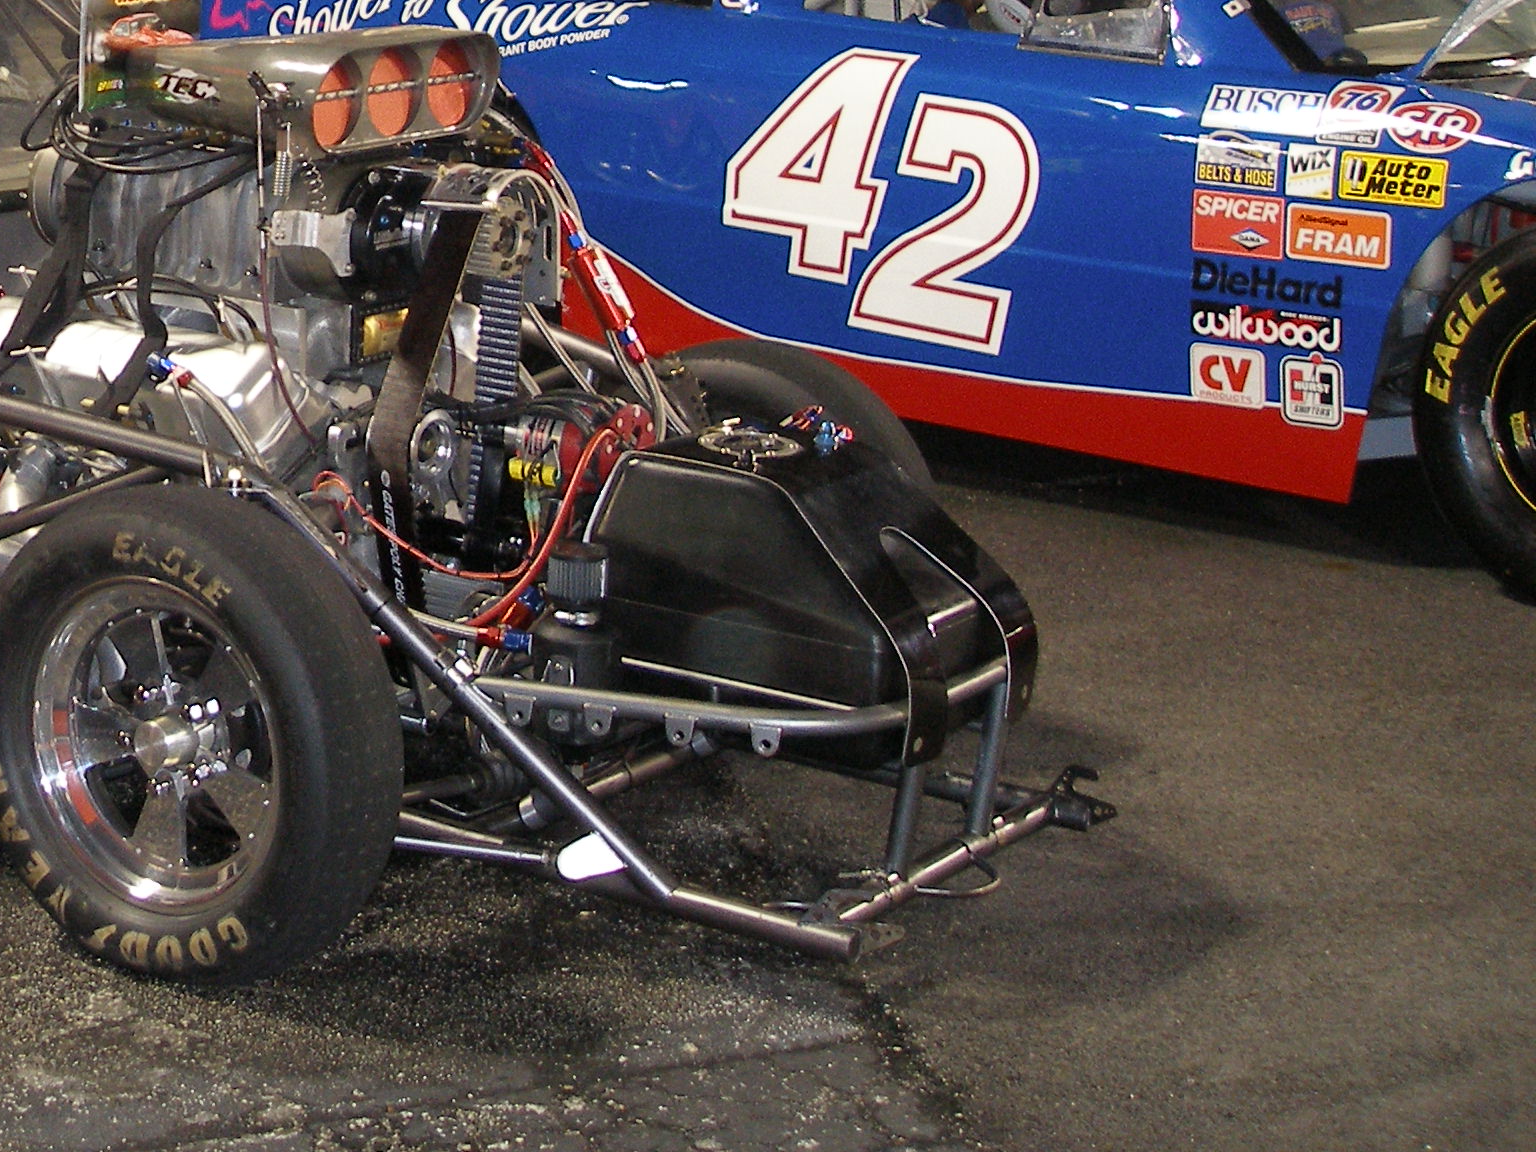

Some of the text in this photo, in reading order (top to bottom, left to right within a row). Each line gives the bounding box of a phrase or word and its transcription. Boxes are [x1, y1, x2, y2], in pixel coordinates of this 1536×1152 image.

[528, 35, 559, 52] BODY
[559, 28, 611, 46] POWDER
[1208, 87, 1324, 115] BUSCH
[1341, 90, 1381, 110] 76
[1395, 105, 1468, 142] STP
[1198, 164, 1275, 186] BELTS & HOSE
[1372, 159, 1432, 180] Auto
[722, 46, 1041, 356] 42
[1369, 177, 1441, 199] Meter
[1195, 194, 1281, 224] SPICER
[1298, 213, 1349, 227] AlliedSignal
[1294, 227, 1381, 258] FRAM
[1192, 258, 1343, 308] DieHard
[1192, 305, 1341, 352] wilwood
[1425, 265, 1507, 404] EAGLE
[1199, 355, 1252, 393] CV
[1293, 380, 1331, 394] HURST
[1199, 389, 1253, 405] PRODUCTS
[111, 531, 233, 608] EAGLE
